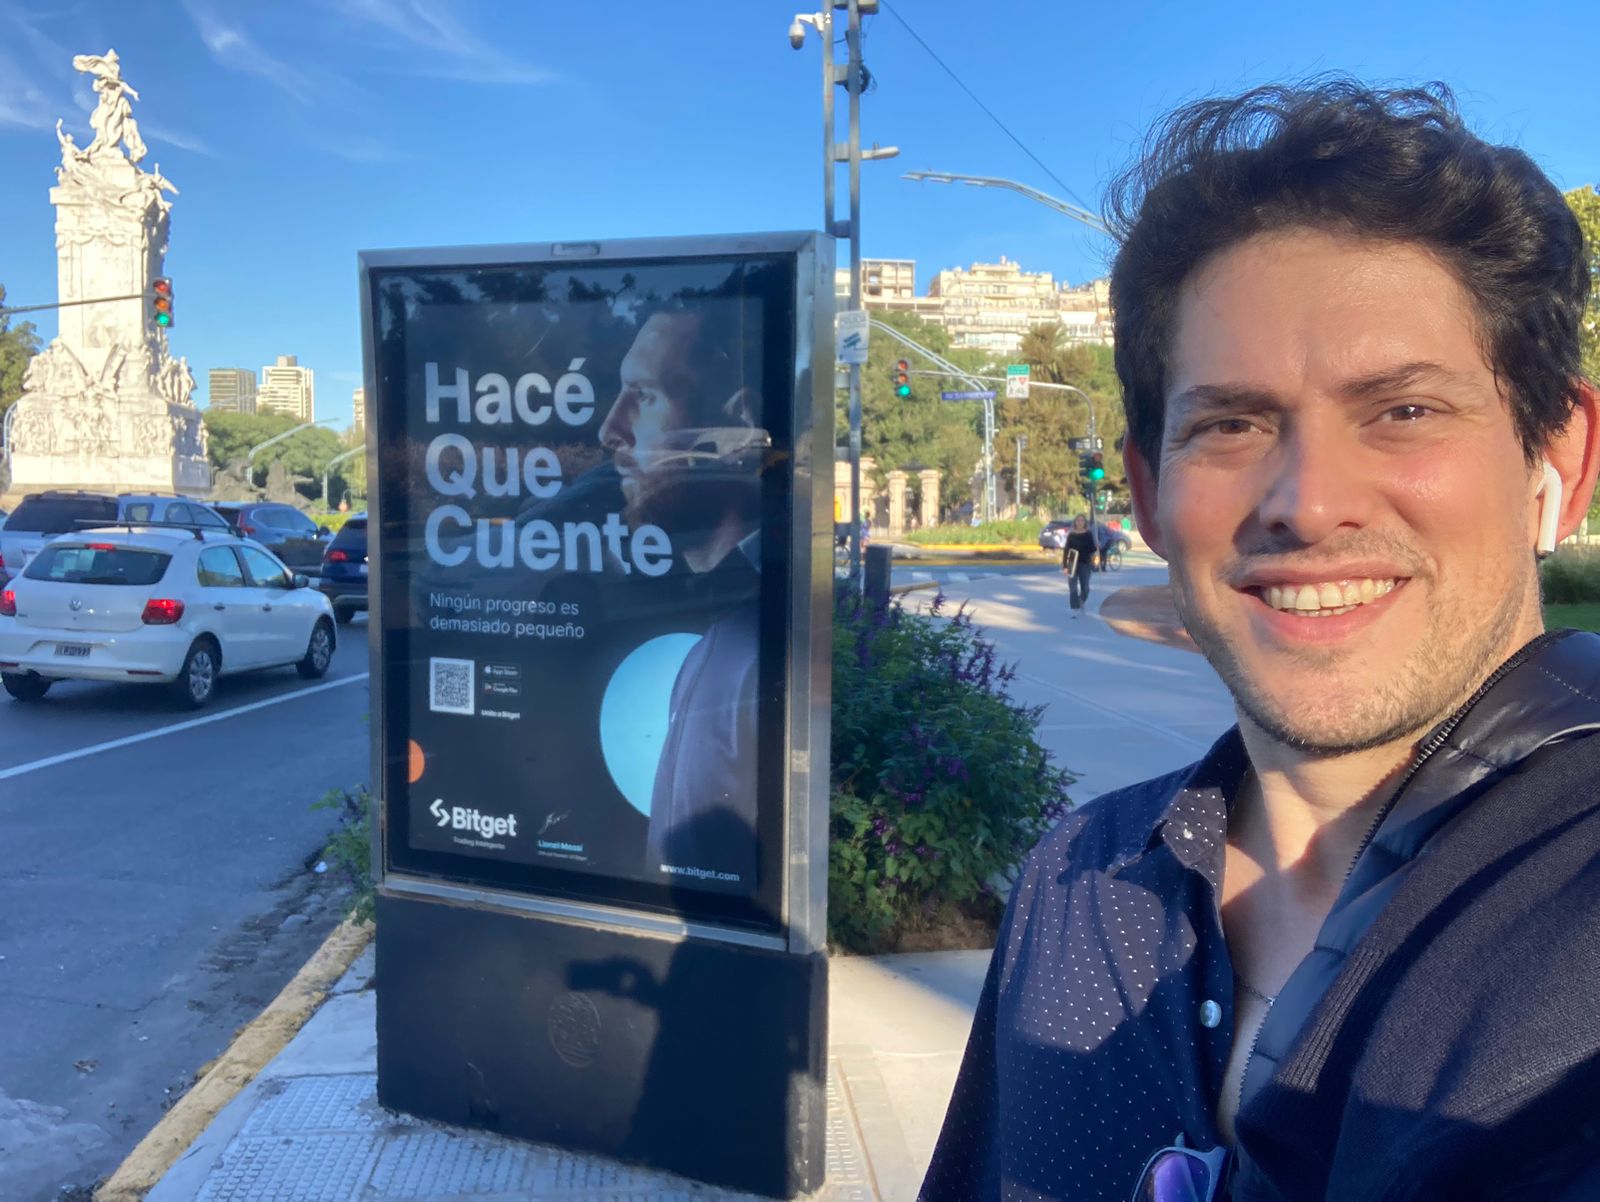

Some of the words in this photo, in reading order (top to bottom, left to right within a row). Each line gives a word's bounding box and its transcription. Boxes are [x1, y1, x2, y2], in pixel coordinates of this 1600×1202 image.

[425, 357, 595, 426] Hacé
[425, 432, 563, 499] Que
[425, 504, 674, 577] Cuente
[429, 592, 481, 613] Ningún
[486, 598, 556, 616] progreso
[560, 602, 580, 616] es
[430, 615, 511, 634] demasiado
[515, 621, 585, 640] pequeño
[452, 806, 517, 838] Bitget
[660, 863, 740, 881] www.bitget.com
